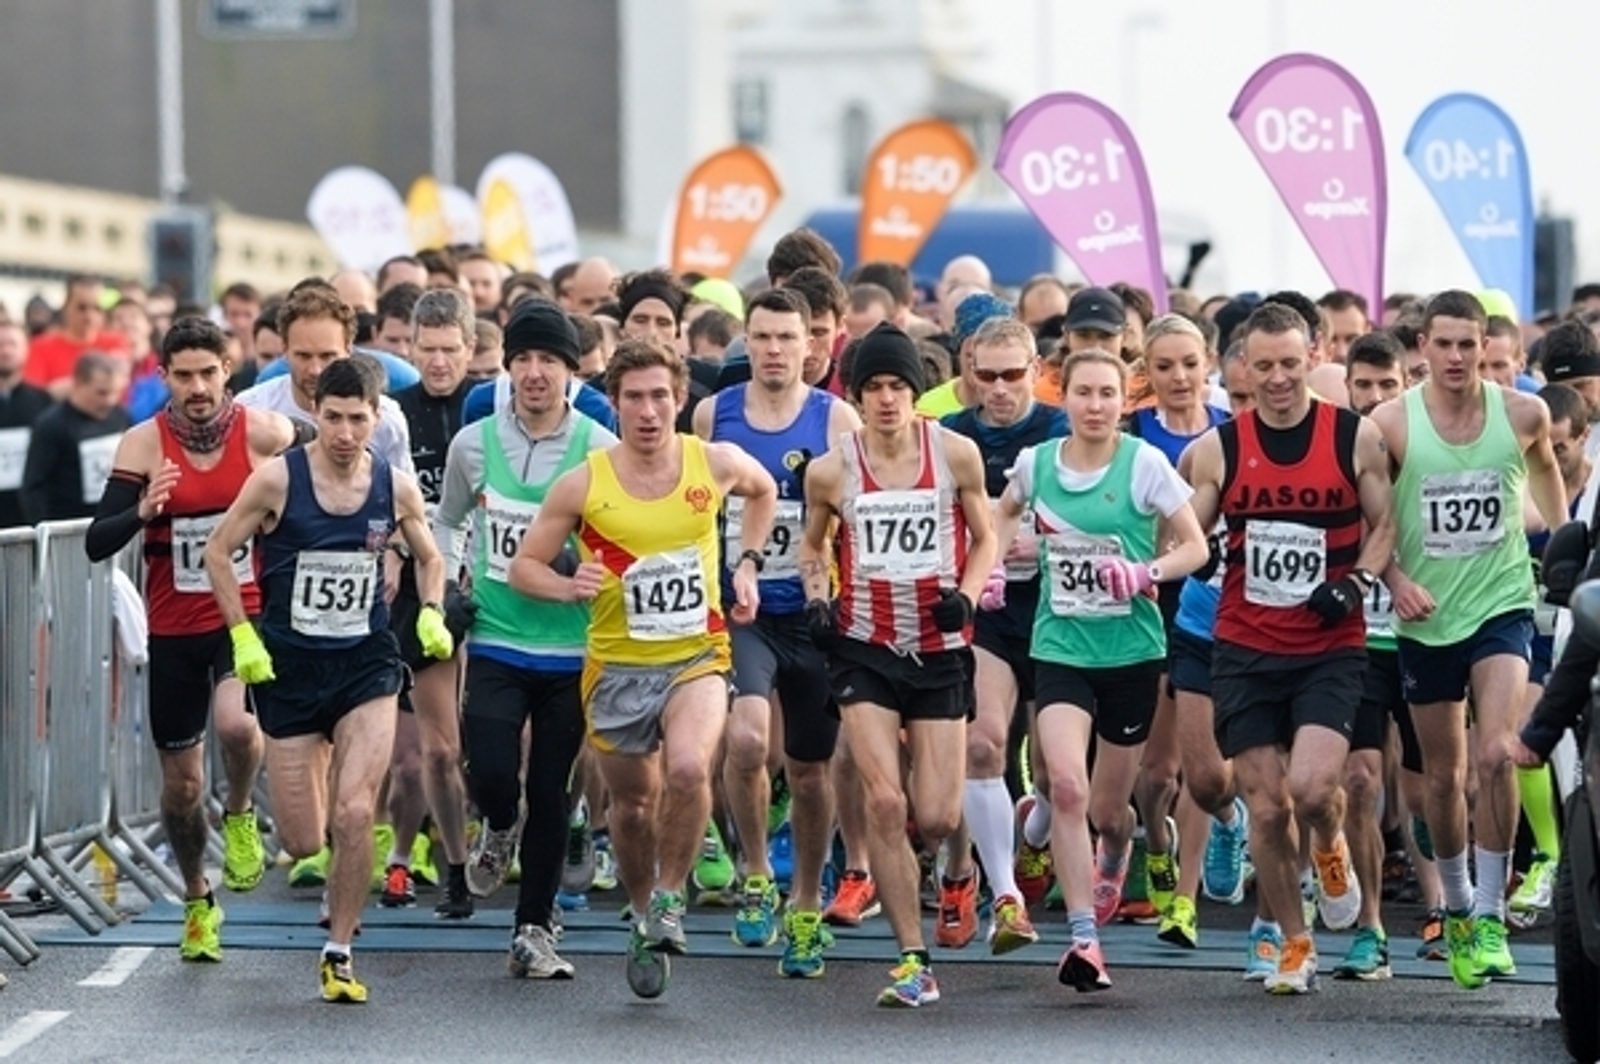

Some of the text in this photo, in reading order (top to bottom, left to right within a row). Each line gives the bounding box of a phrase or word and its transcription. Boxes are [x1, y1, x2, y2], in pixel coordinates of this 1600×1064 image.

[878, 154, 962, 194] 1:50
[688, 183, 768, 222] 1:50
[1233, 485, 1343, 510] JASON
[1429, 496, 1502, 533] 1329
[491, 522, 526, 558] 16
[865, 517, 936, 553] 1762
[1252, 546, 1321, 583] 1699
[303, 576, 370, 612] 1531
[632, 575, 704, 615] 1425
